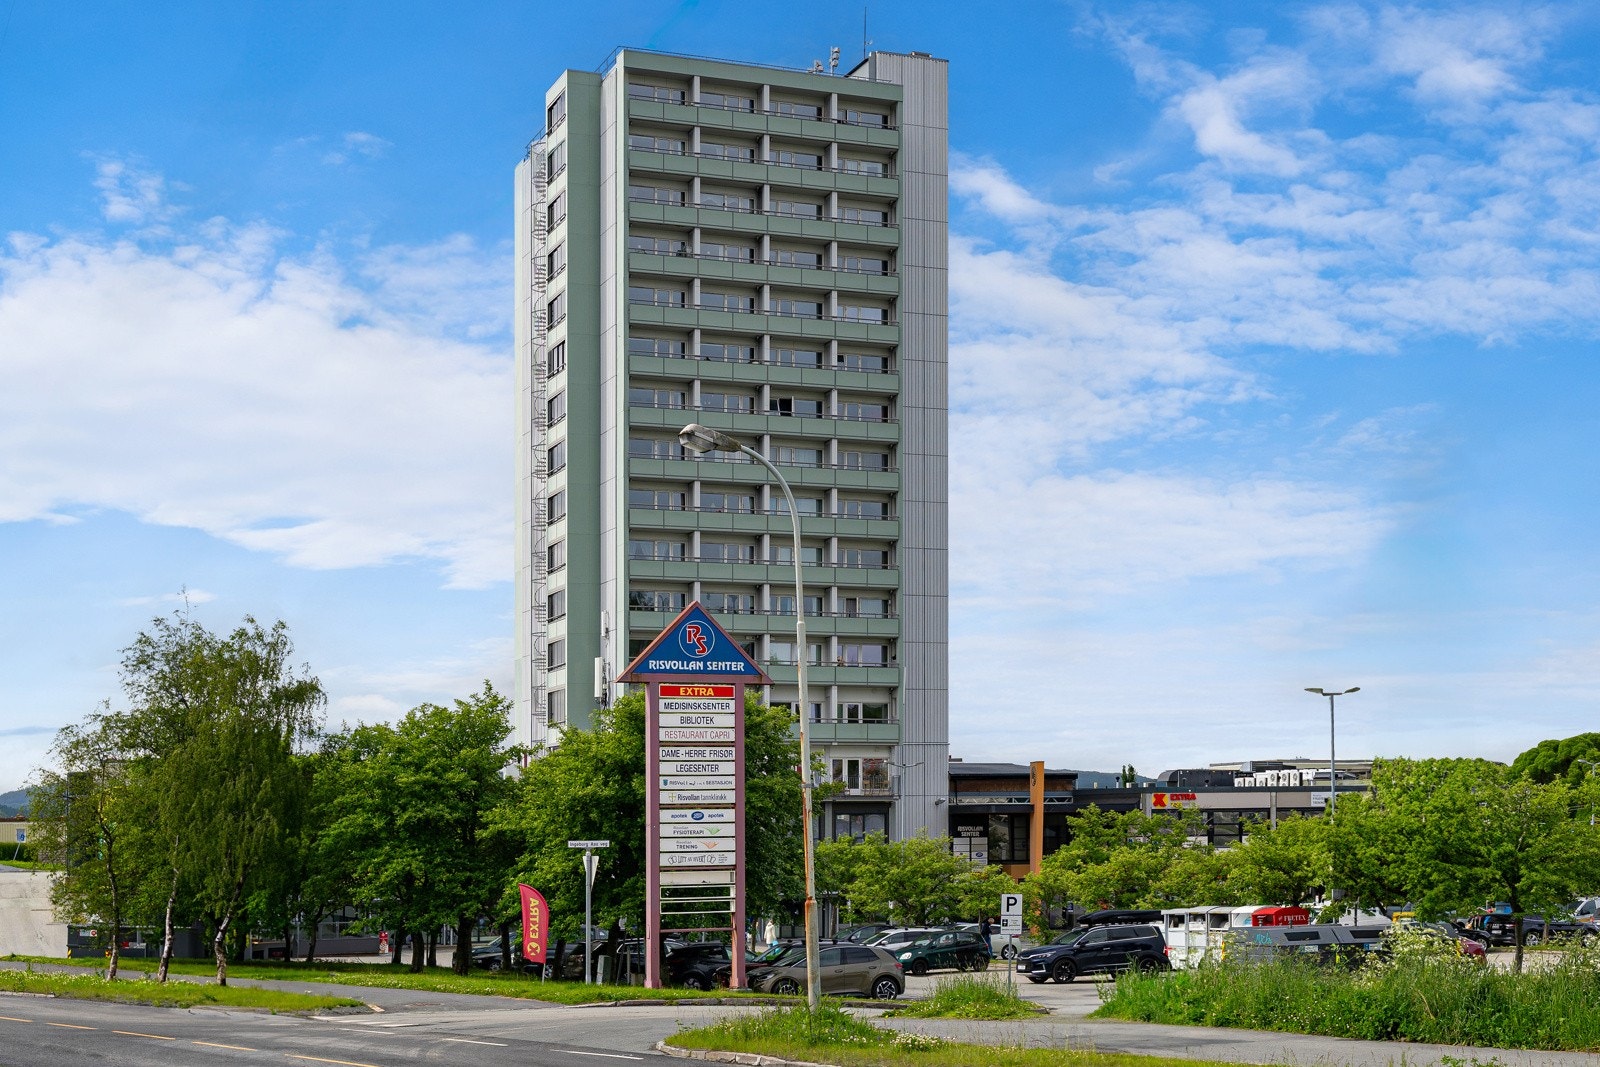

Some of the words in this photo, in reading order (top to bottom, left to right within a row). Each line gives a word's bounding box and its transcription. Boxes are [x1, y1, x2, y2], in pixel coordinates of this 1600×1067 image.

[649, 660, 703, 671] RISVOLLAN
[707, 661, 745, 672] SENTER
[680, 687, 714, 696] EXTRA
[664, 702, 730, 710] MEDISINSKSENTER
[680, 716, 714, 724] BIBLIOTEK
[664, 730, 708, 739] RESTAURANT
[710, 730, 730, 739] CAPRI
[709, 750, 734, 758] FRISØR
[676, 764, 720, 772] LEGESENTER
[1006, 896, 1018, 912] P
